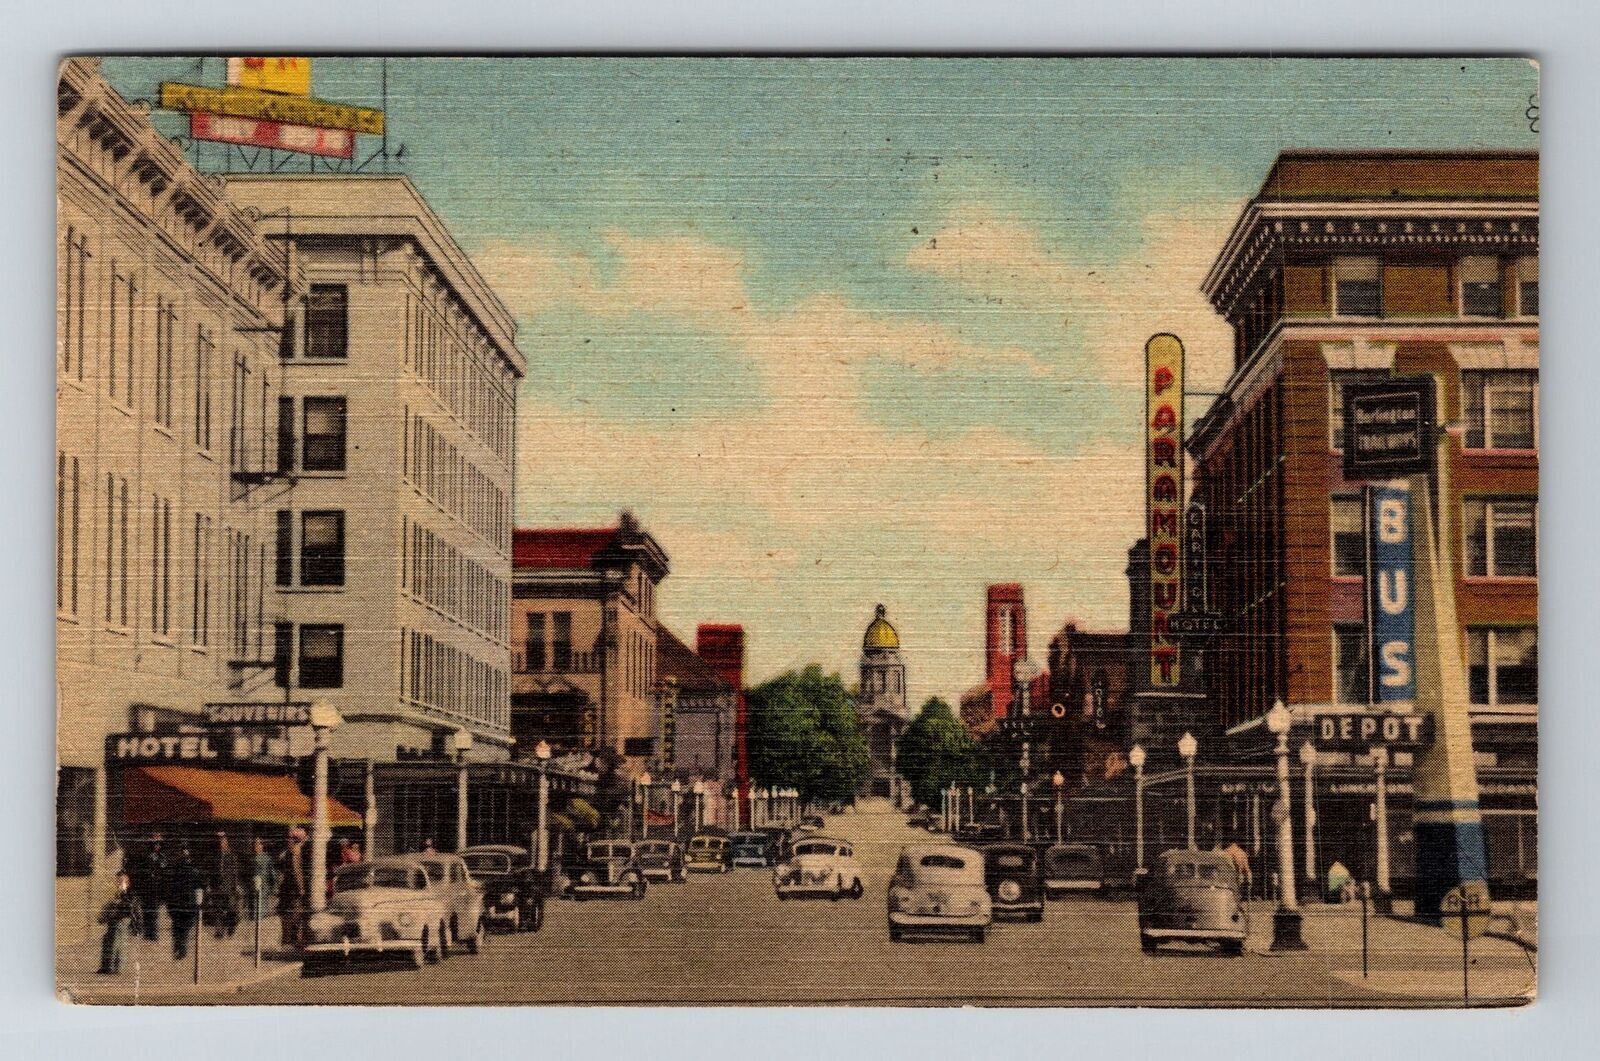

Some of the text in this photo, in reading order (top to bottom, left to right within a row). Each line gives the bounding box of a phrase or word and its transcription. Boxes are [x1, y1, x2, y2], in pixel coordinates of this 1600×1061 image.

[1151, 366, 1178, 683] PARAMOUNT
[1378, 499, 1411, 687] BUS
[1170, 619, 1222, 630] HOTEL
[1320, 717, 1425, 741] DEPOT
[117, 737, 218, 759] HOTEL
